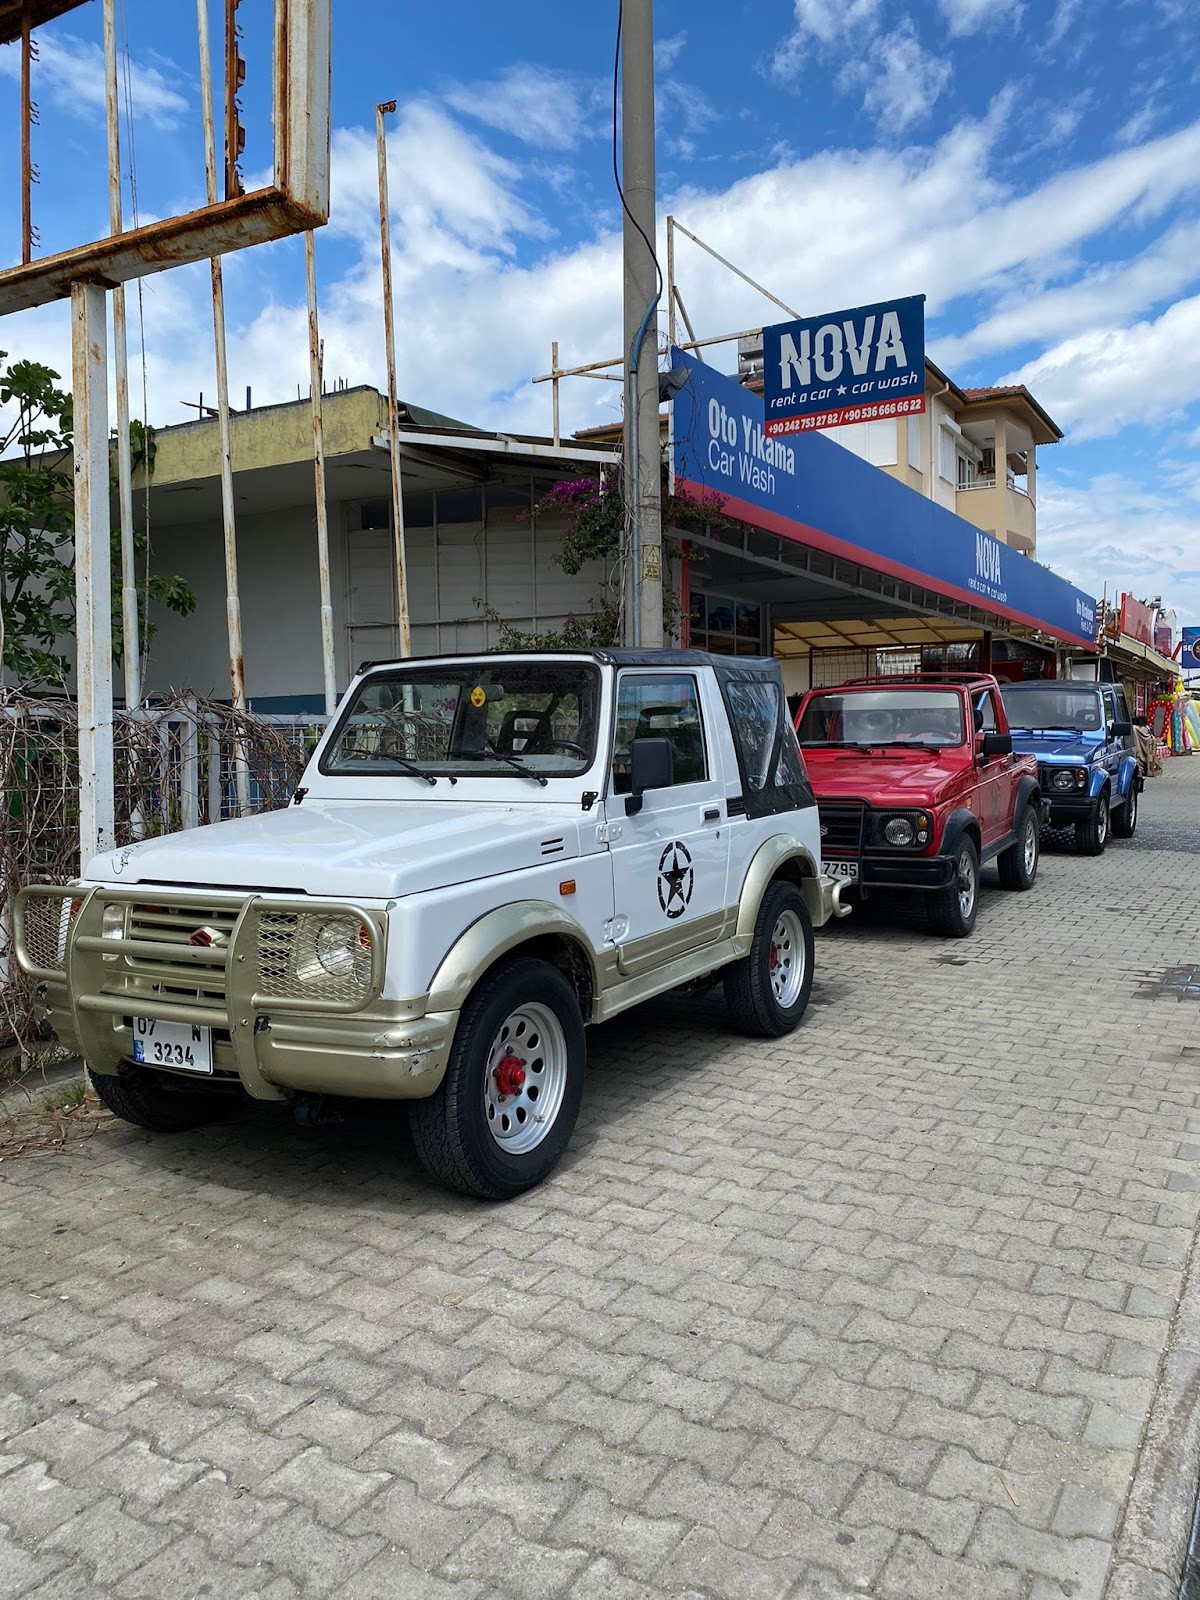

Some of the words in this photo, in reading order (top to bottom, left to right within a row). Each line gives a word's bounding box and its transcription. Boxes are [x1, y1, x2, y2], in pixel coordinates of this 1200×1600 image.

[779, 311, 908, 390] NOVA
[771, 392, 799, 409] rent
[800, 392, 808, 404] a
[811, 388, 833, 401] car
[852, 381, 876, 394] car
[877, 370, 918, 390] wash
[708, 397, 737, 447] Oto
[768, 423, 784, 434] +90
[784, 419, 800, 431] 242
[800, 416, 816, 429] 753
[815, 414, 827, 426] 27
[827, 412, 839, 424] 82
[844, 409, 861, 421] +90
[861, 405, 878, 418] 536
[878, 402, 897, 416] 666
[896, 400, 909, 413] 66
[909, 398, 922, 411] 22
[708, 438, 736, 477] Car
[738, 451, 776, 496] Wash
[975, 532, 1001, 586] NOVA
[823, 862, 857, 876] 7795
[137, 1017, 157, 1036] 07
[154, 1041, 195, 1066] 3234
